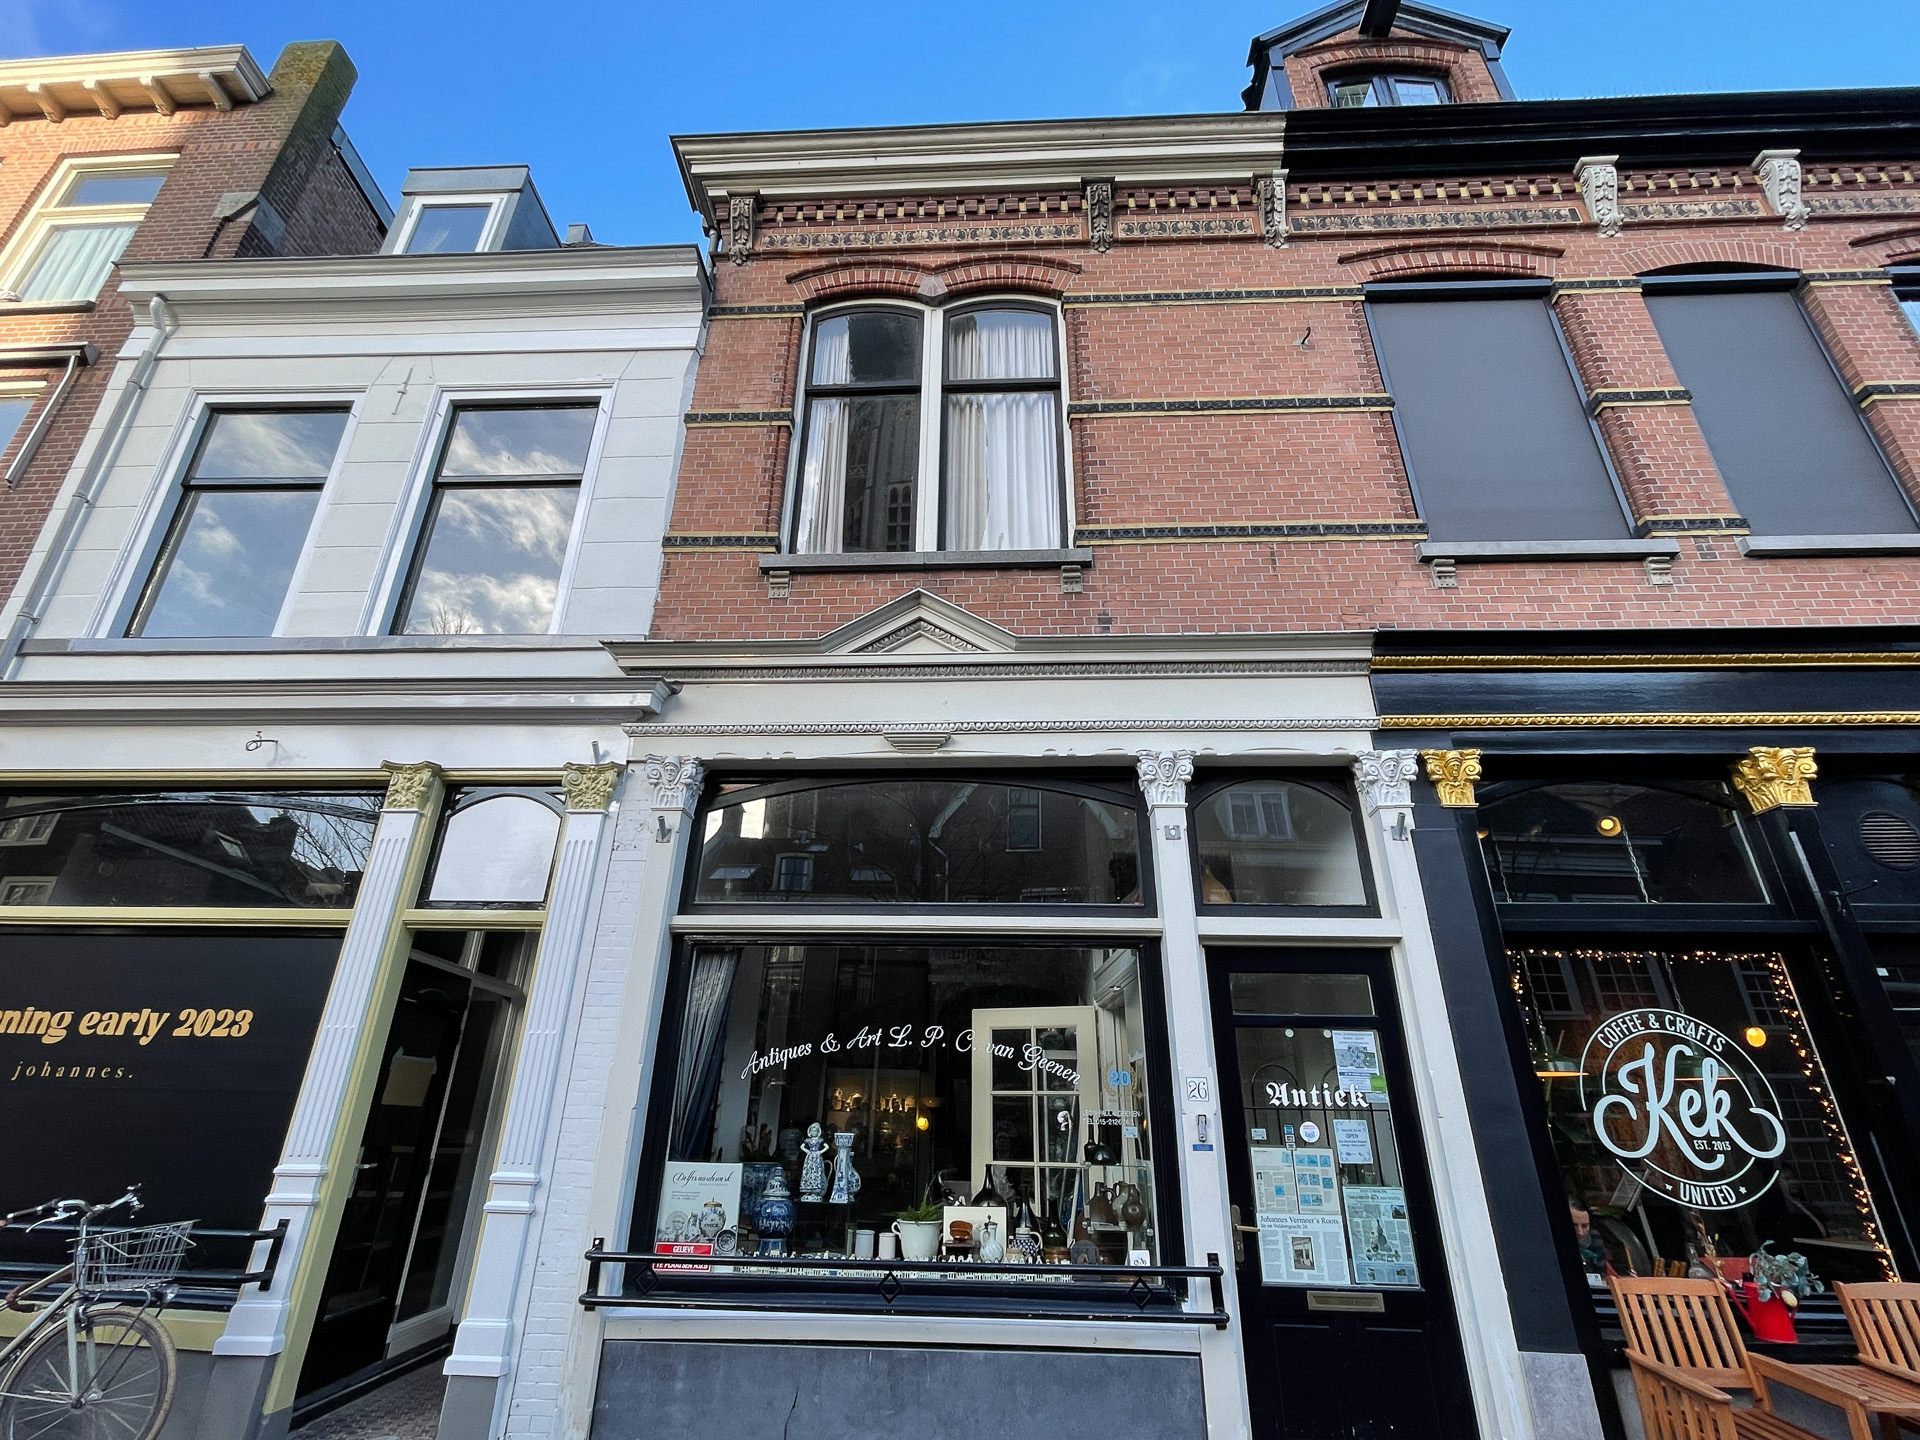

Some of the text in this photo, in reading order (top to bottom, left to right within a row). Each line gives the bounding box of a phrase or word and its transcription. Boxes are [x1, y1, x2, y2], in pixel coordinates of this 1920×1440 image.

[0, 1006, 254, 1046] ning early 2023
[1598, 1013, 1726, 1052] COFFEE & CRAFTS
[740, 1024, 1081, 1085] Antiques & Art L. P. C. van Geenen
[11, 1061, 133, 1081] johannes.
[1109, 1070, 1131, 1087] 20
[1188, 1080, 1208, 1100] 26
[1265, 1081, 1369, 1108] Antiek
[1593, 1042, 1786, 1170] Kek
[1693, 1140, 1731, 1151] EST. 2013
[1679, 1182, 1736, 1206] UNITED
[1260, 1215, 1339, 1225] Johannes Vermeer's Roots
